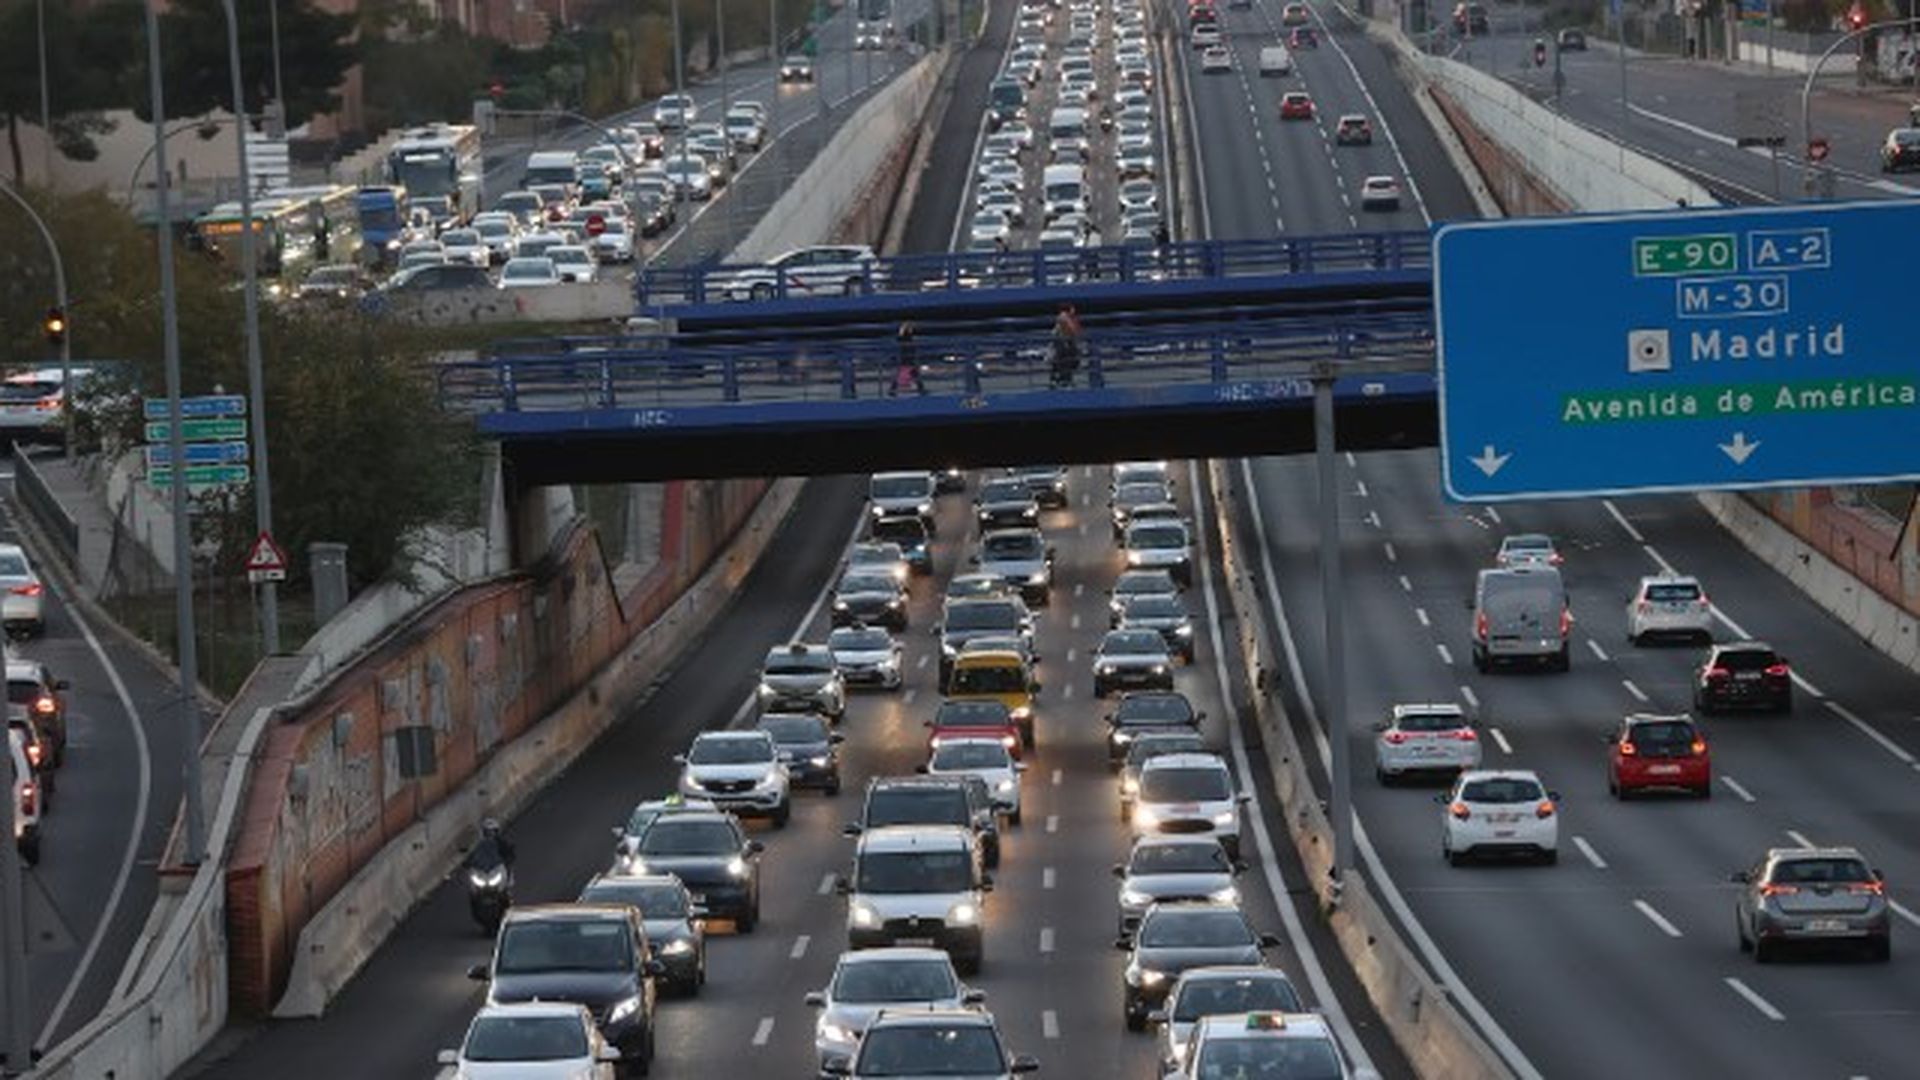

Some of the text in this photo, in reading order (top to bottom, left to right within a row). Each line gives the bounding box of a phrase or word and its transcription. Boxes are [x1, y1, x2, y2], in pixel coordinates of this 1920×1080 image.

[1640, 236, 1822, 270] E-90 A-2
[1685, 282, 1781, 311] M-30
[1691, 324, 1844, 361] Madrid
[1563, 383, 1915, 421] Avenida de América
